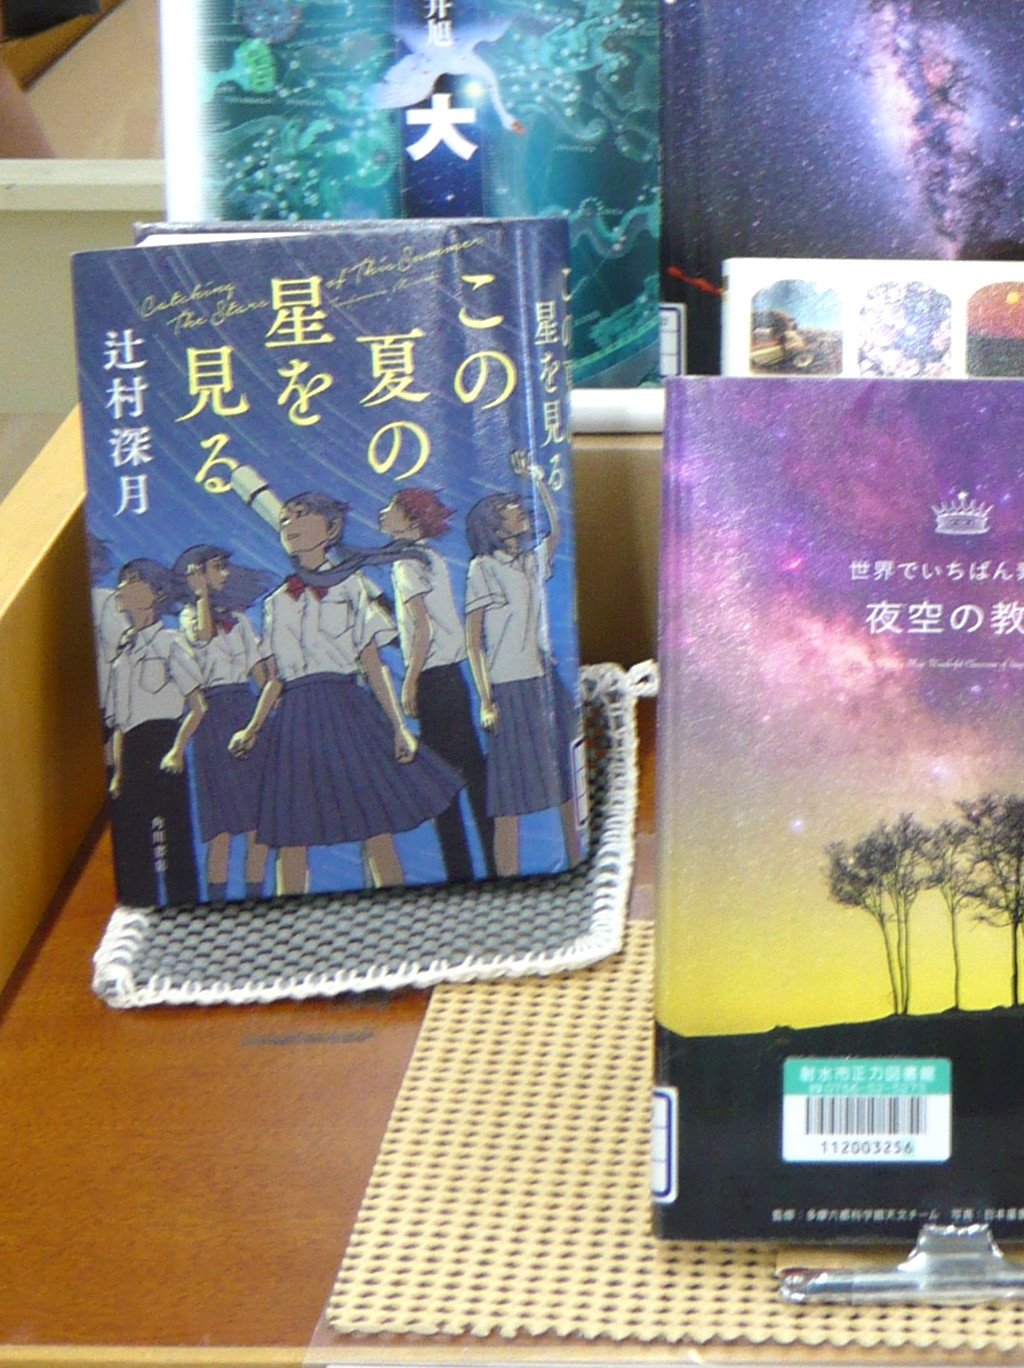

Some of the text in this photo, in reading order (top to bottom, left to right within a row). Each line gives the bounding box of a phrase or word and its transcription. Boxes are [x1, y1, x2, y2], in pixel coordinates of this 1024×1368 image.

[405, 93, 479, 161] 大
[264, 274, 336, 426] 星を
[356, 328, 432, 481] 夏の
[454, 274, 518, 410] この
[103, 329, 154, 517] 辻村深月
[174, 346, 251, 495] 見る
[821, 1141, 914, 1155] 112003256
